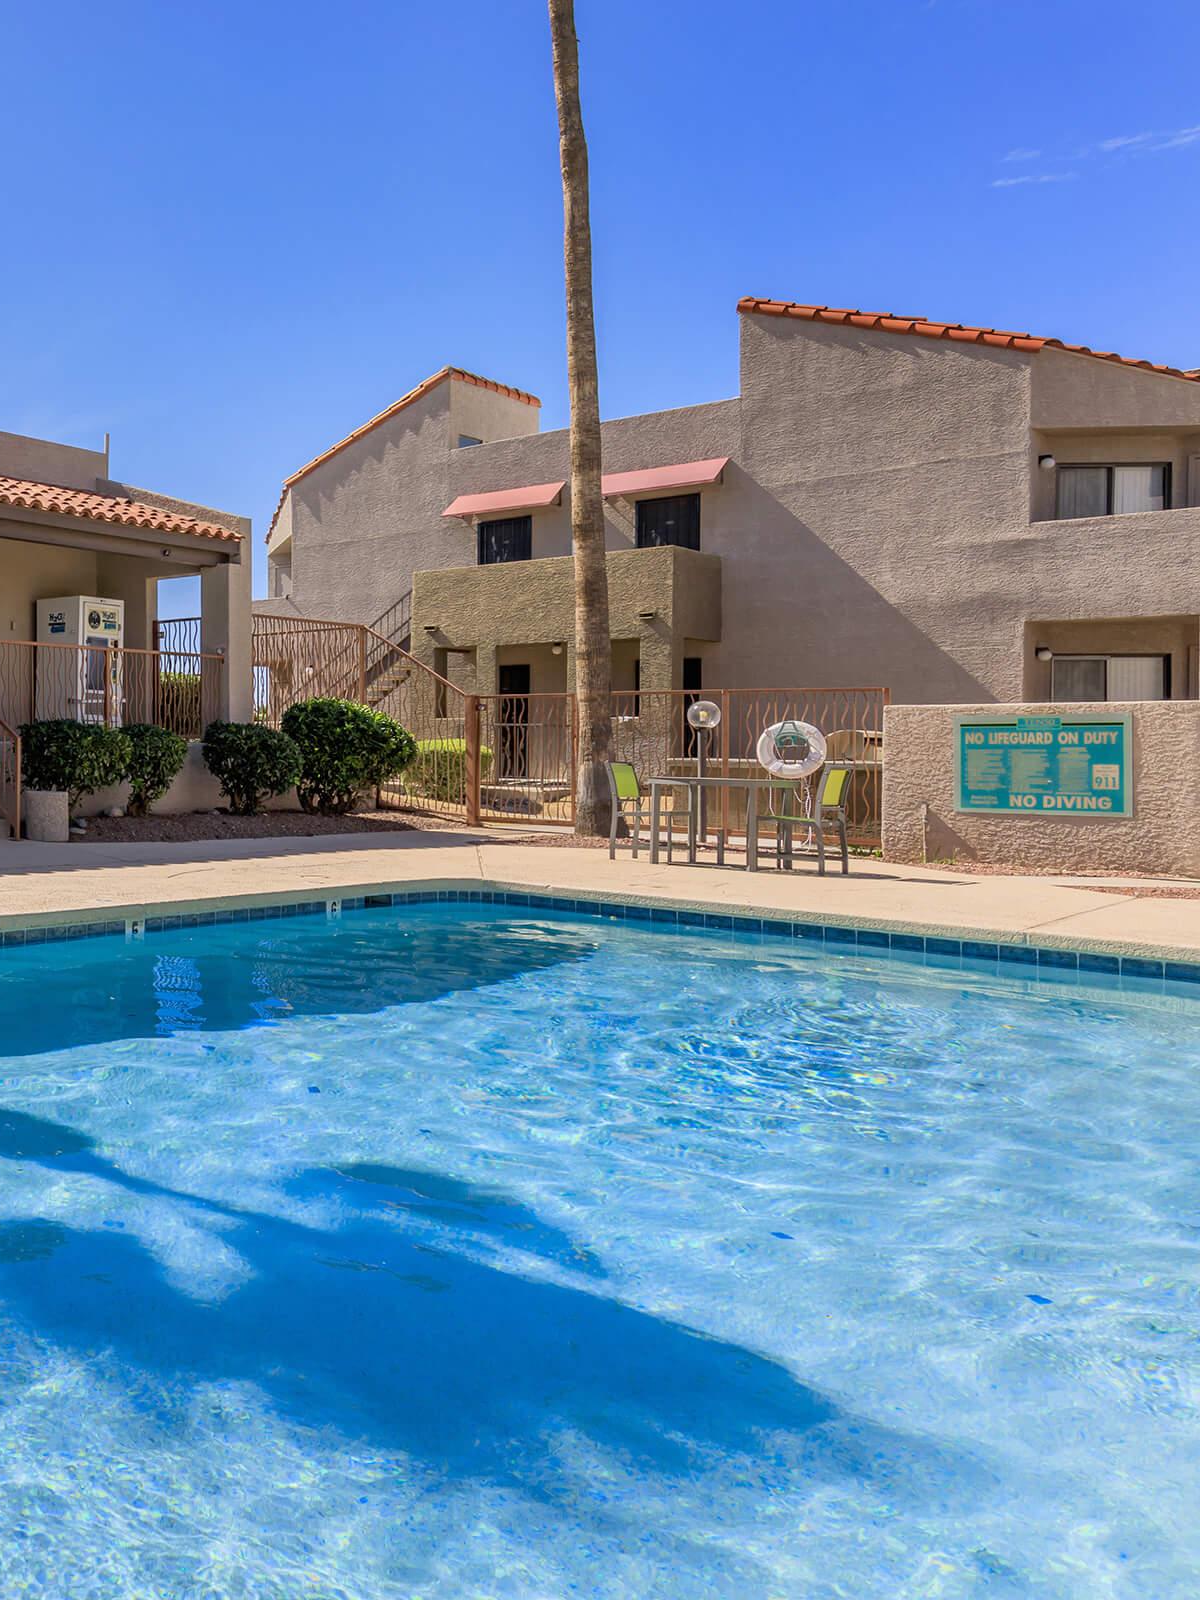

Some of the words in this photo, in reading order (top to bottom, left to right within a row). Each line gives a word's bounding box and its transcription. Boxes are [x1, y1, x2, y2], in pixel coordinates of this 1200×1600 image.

[965, 732, 984, 744] NO
[988, 732, 1053, 744] LIFEGUARD
[1058, 731, 1079, 744] ON
[1084, 731, 1118, 744] DUTY
[1095, 776, 1117, 788] 911
[1009, 795, 1037, 808] NO
[1043, 795, 1112, 809] DIVING
